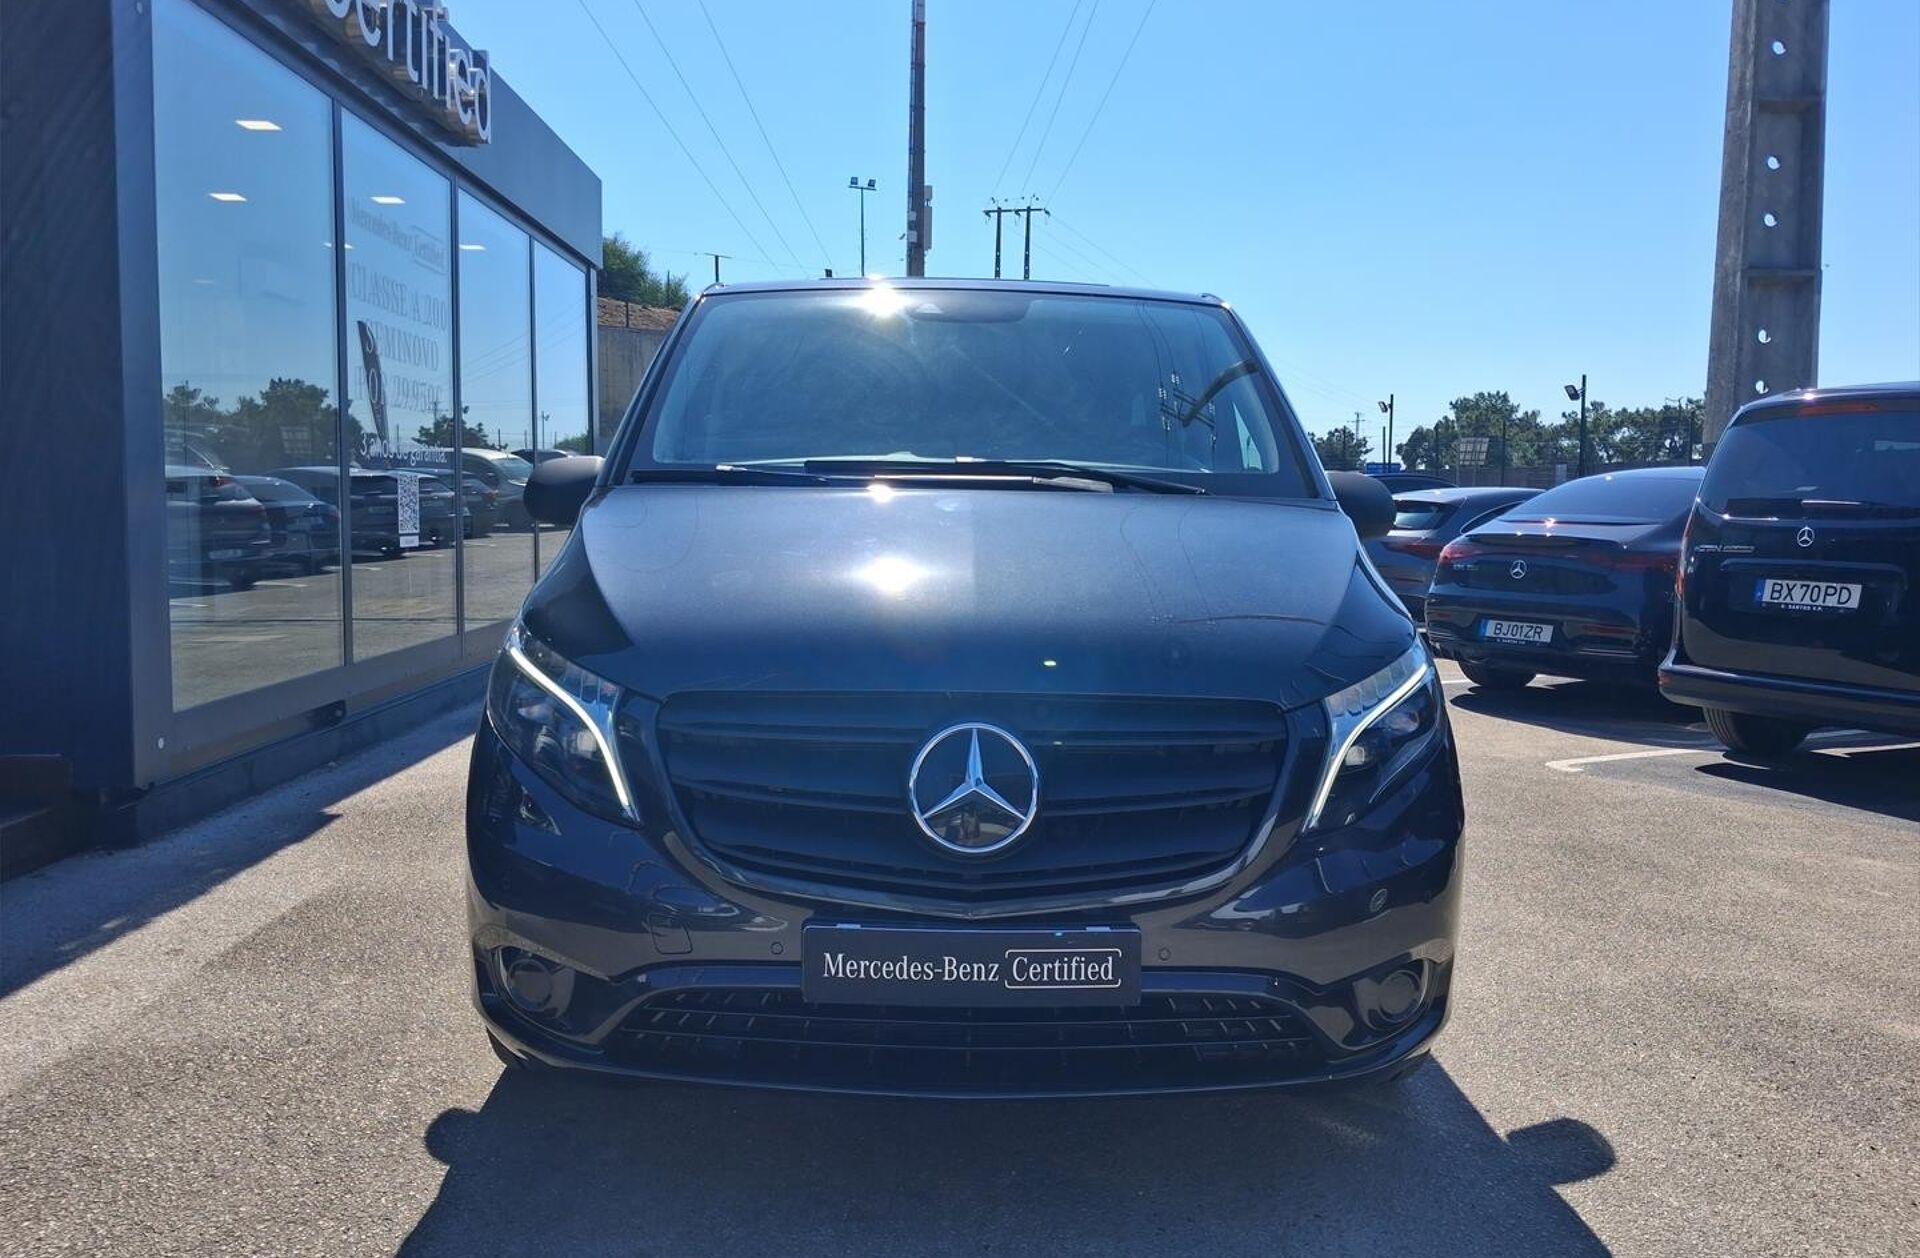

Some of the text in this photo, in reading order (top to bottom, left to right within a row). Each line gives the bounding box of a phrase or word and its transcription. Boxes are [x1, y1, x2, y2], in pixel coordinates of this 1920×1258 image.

[325, 0, 492, 145] ertified
[1493, 622, 1543, 639] BJ01ZR
[823, 952, 1114, 982] Mercedes-Benz Certified
